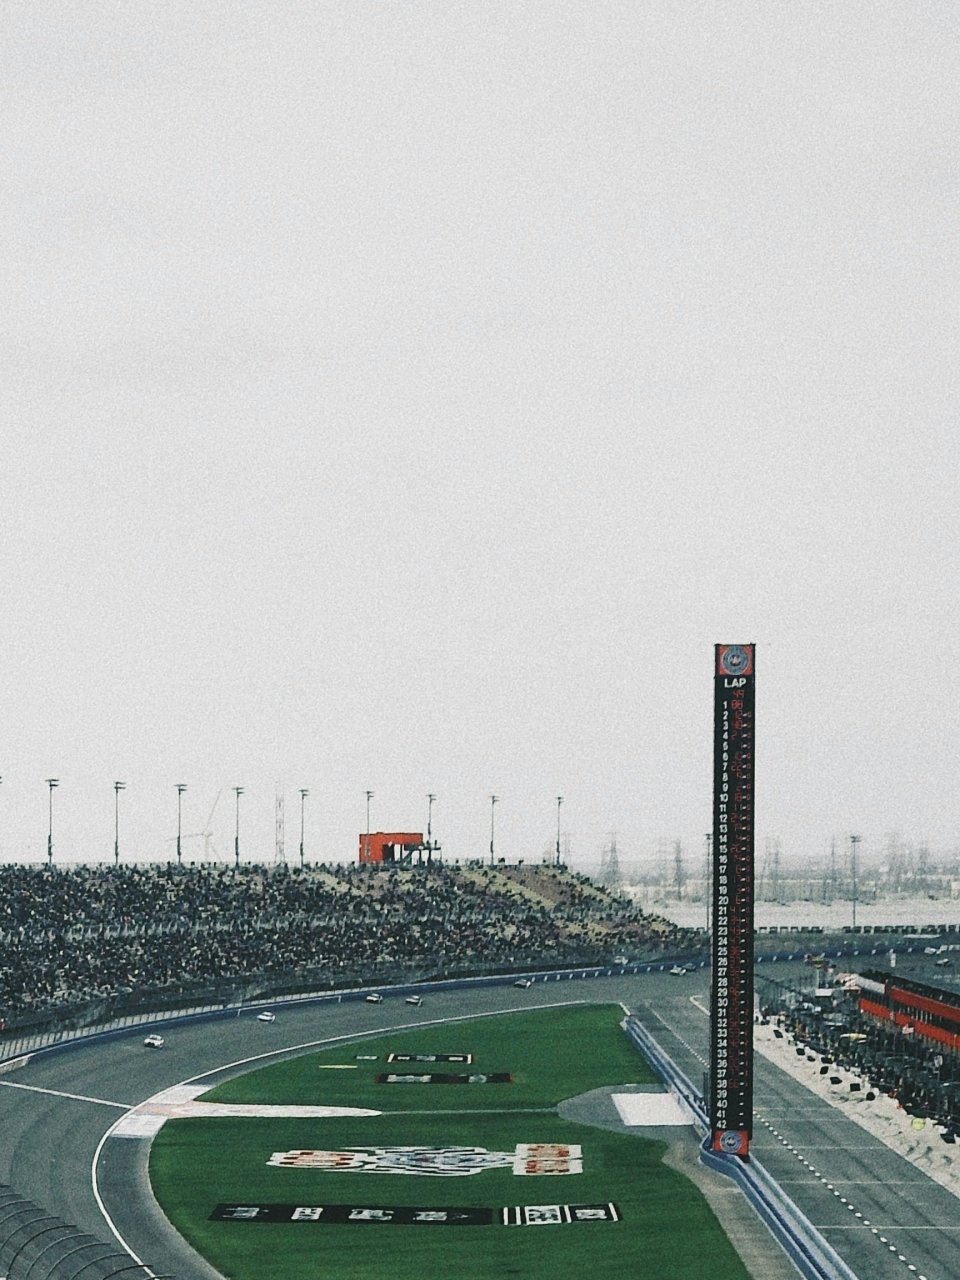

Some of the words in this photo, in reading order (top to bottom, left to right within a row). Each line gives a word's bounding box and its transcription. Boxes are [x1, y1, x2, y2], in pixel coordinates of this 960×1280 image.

[724, 678, 747, 688] LAP
[719, 793, 729, 803] 10
[719, 803, 727, 813] 11
[719, 813, 728, 823] 12
[718, 885, 728, 895] 19
[718, 895, 729, 905] 20
[718, 905, 727, 916] 21
[717, 916, 728, 926] 22
[717, 926, 728, 936] 23
[717, 936, 728, 946] 24
[717, 946, 728, 956] 25
[717, 957, 728, 966] 26
[717, 967, 728, 977] 27
[717, 977, 728, 987] 28
[717, 987, 728, 997] 29
[717, 997, 729, 1007] 30
[717, 1008, 727, 1017] 31
[717, 1018, 728, 1028] 32
[717, 1028, 728, 1038] 33
[716, 1038, 728, 1048] 34
[717, 1048, 728, 1058] 35
[716, 1059, 728, 1068] 36
[716, 1068, 727, 1078] 37
[716, 1079, 728, 1089] 38
[716, 1089, 728, 1099] 39
[716, 1099, 728, 1109] 40
[716, 1109, 726, 1118] 41
[716, 1119, 727, 1129] 42
